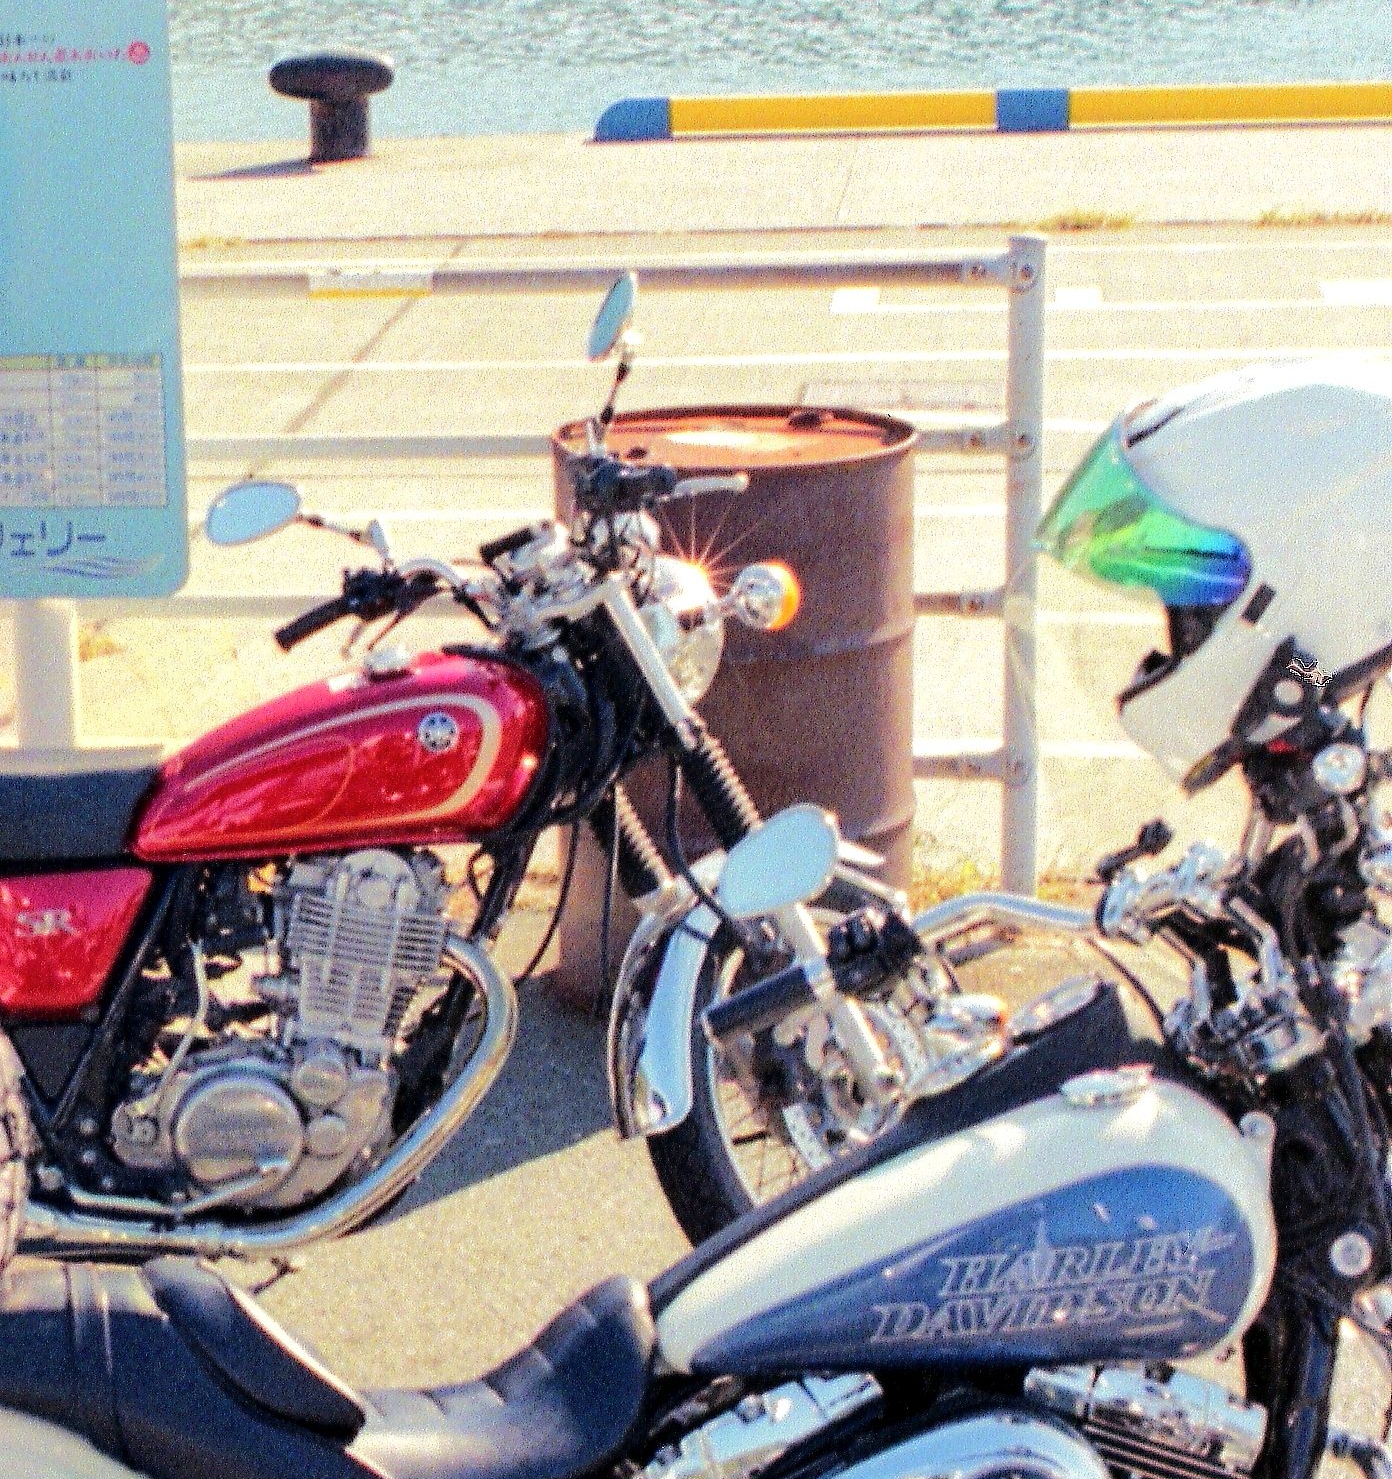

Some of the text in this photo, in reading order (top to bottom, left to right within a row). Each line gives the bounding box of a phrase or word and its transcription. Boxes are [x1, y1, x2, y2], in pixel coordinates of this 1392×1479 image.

[14, 908, 83, 938] SR
[938, 1221, 1236, 1300] HARLEY
[870, 1267, 1228, 1343] DAVIDSON
